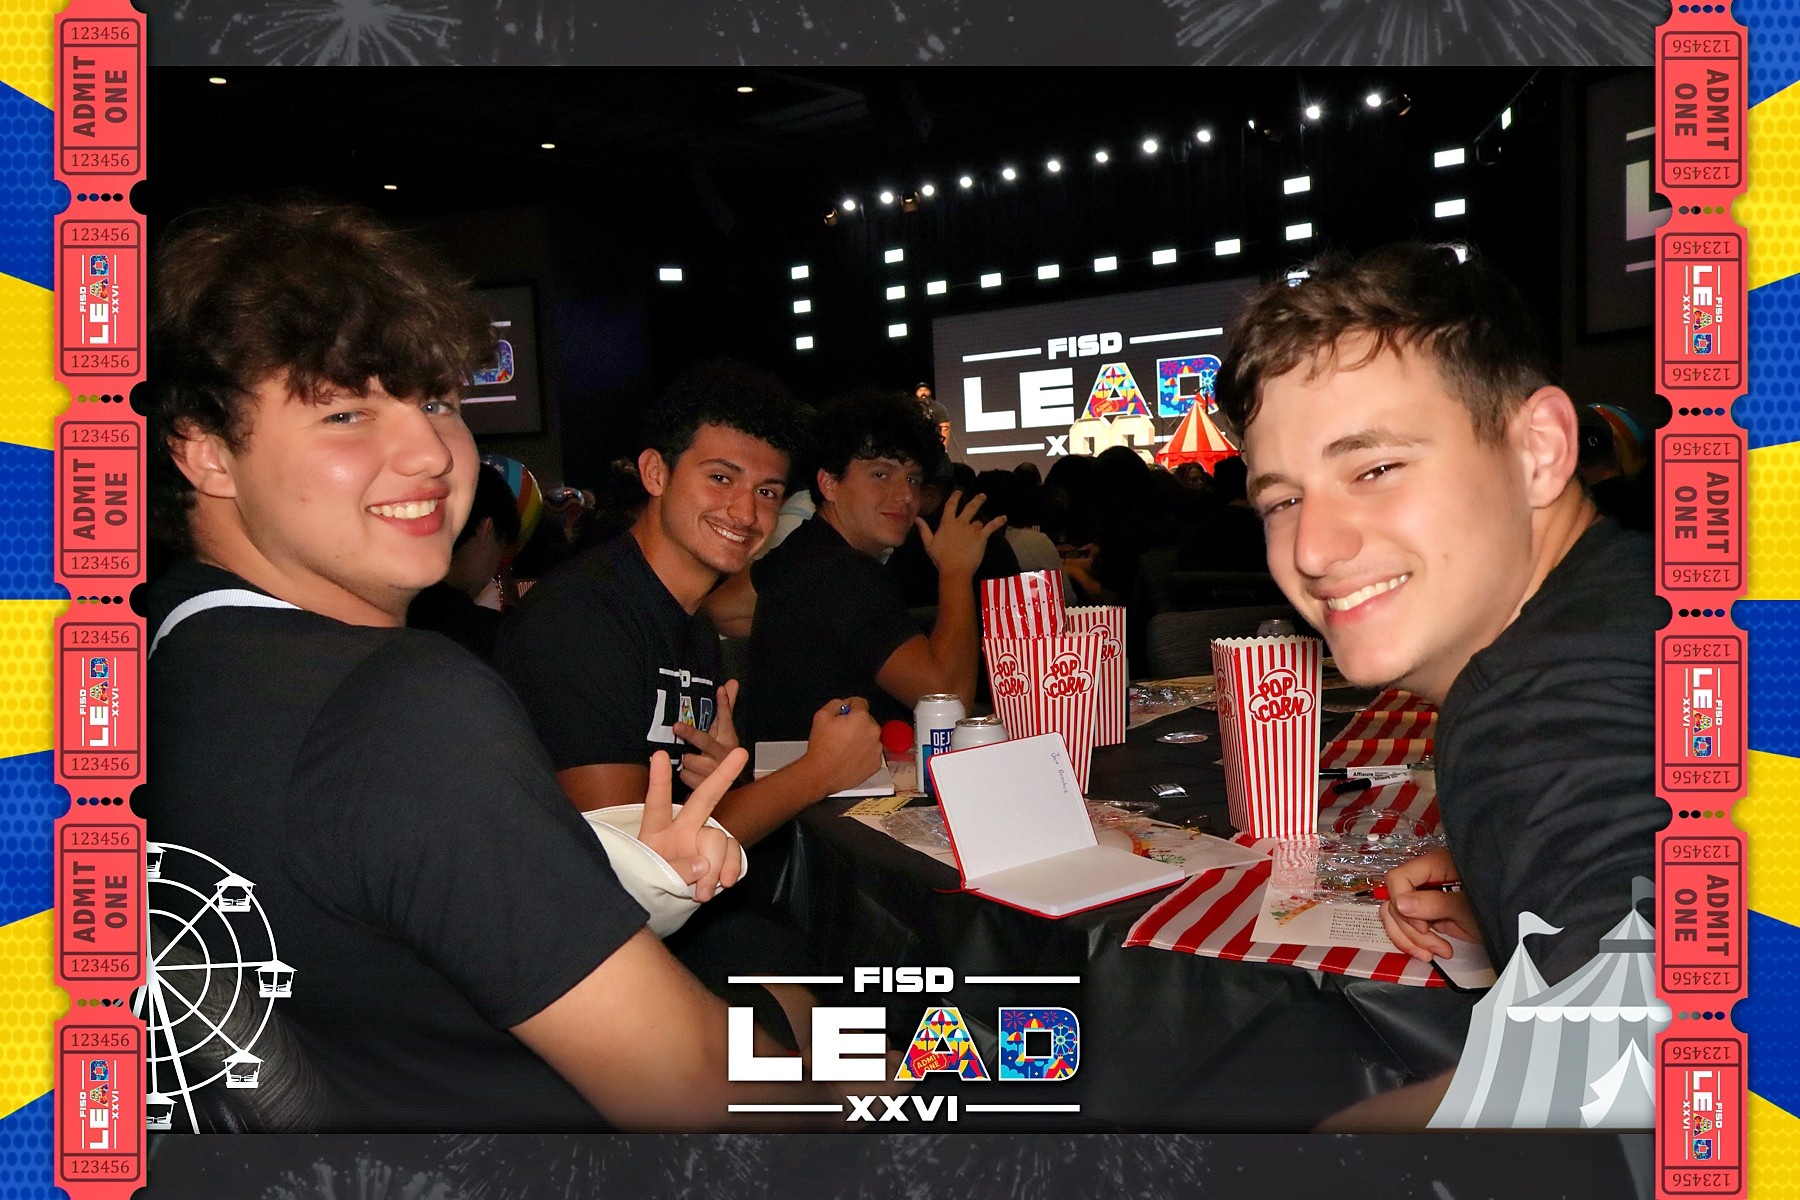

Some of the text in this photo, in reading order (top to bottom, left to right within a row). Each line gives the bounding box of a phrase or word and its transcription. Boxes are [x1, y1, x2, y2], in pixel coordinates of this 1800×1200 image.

[1047, 331, 1123, 360] FISD
[963, 354, 1223, 432] LEAD
[1101, 645, 1116, 659] RN
[996, 661, 1016, 680] POP
[1050, 660, 1077, 680] POP
[998, 677, 1025, 697] CORN
[1049, 677, 1086, 698] CORN
[1258, 677, 1294, 702] POP
[646, 689, 713, 745] LAD
[1258, 696, 1304, 723] CORN
[933, 731, 953, 747] DEJ
